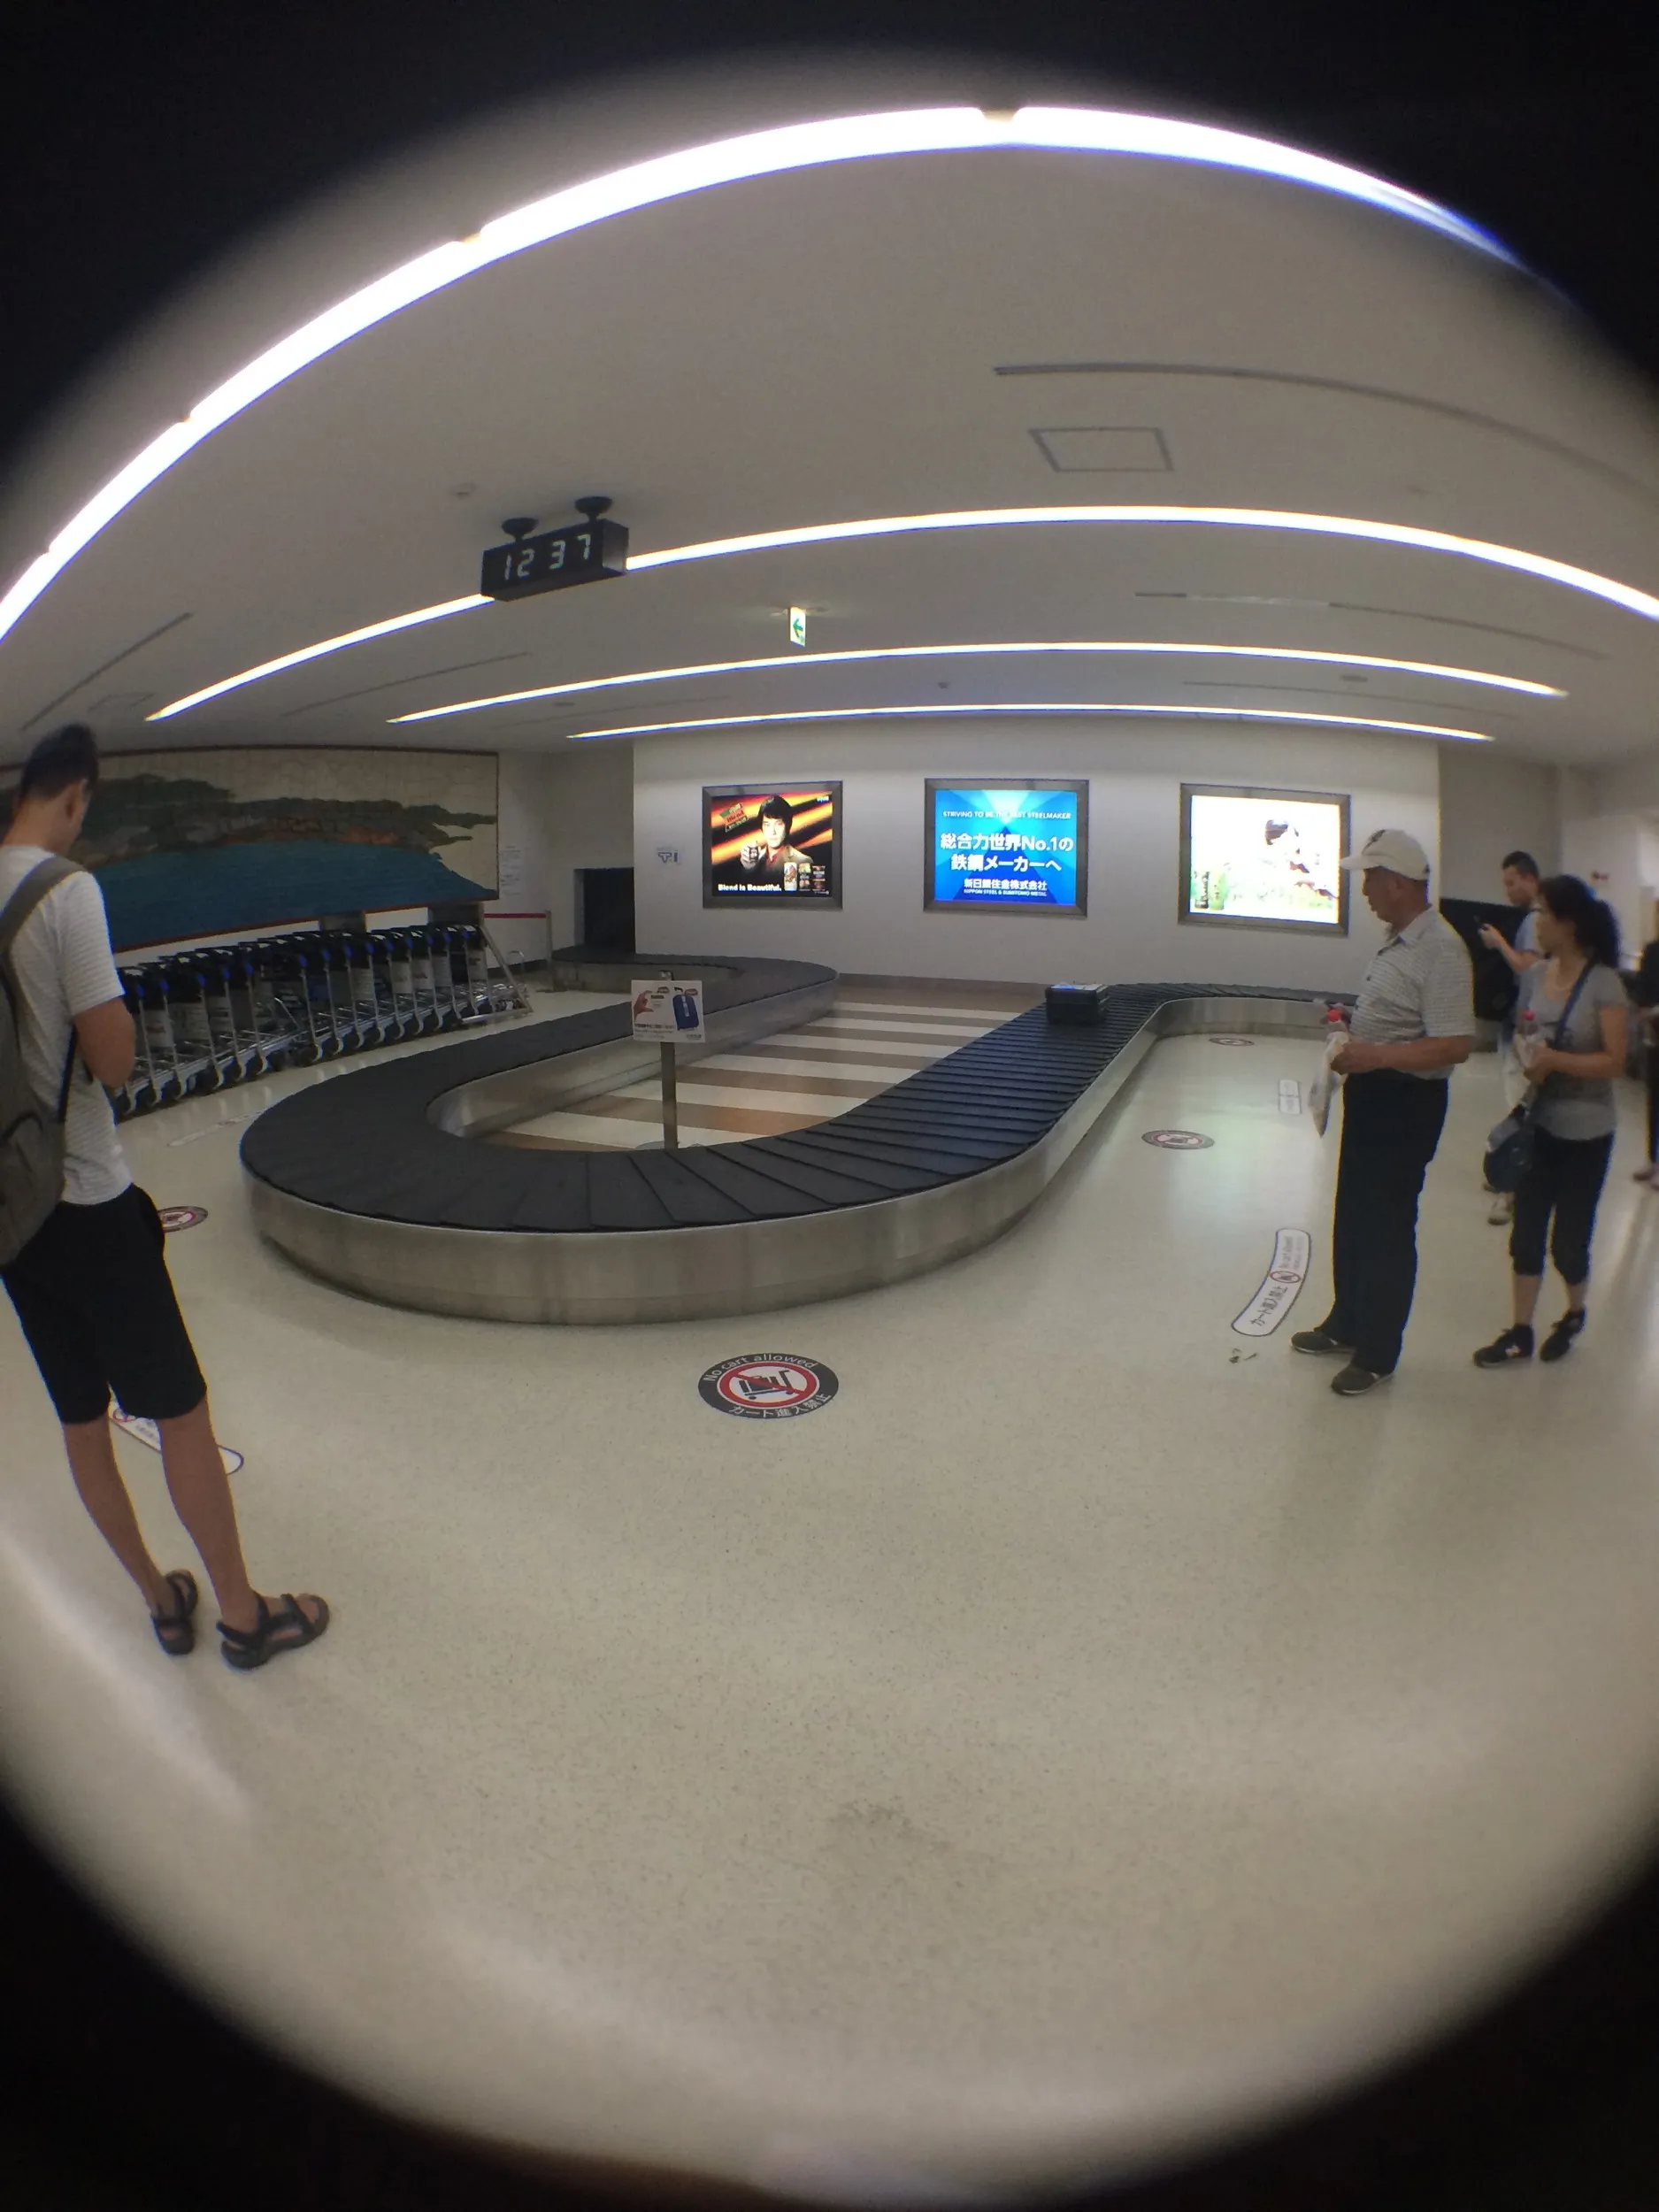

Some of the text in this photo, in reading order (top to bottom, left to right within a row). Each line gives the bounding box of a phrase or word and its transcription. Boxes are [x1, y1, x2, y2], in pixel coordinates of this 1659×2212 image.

[942, 810, 972, 818] STRIVING
[940, 833, 1074, 852] 総合力世界No.1の
[950, 854, 1062, 872] 鉄鋼メーカーへ
[718, 883, 738, 892] Blend
[747, 883, 782, 892] Beautiful.
[703, 1353, 818, 1382] No cart allowed
[728, 1393, 832, 1418] カート進入禁止
